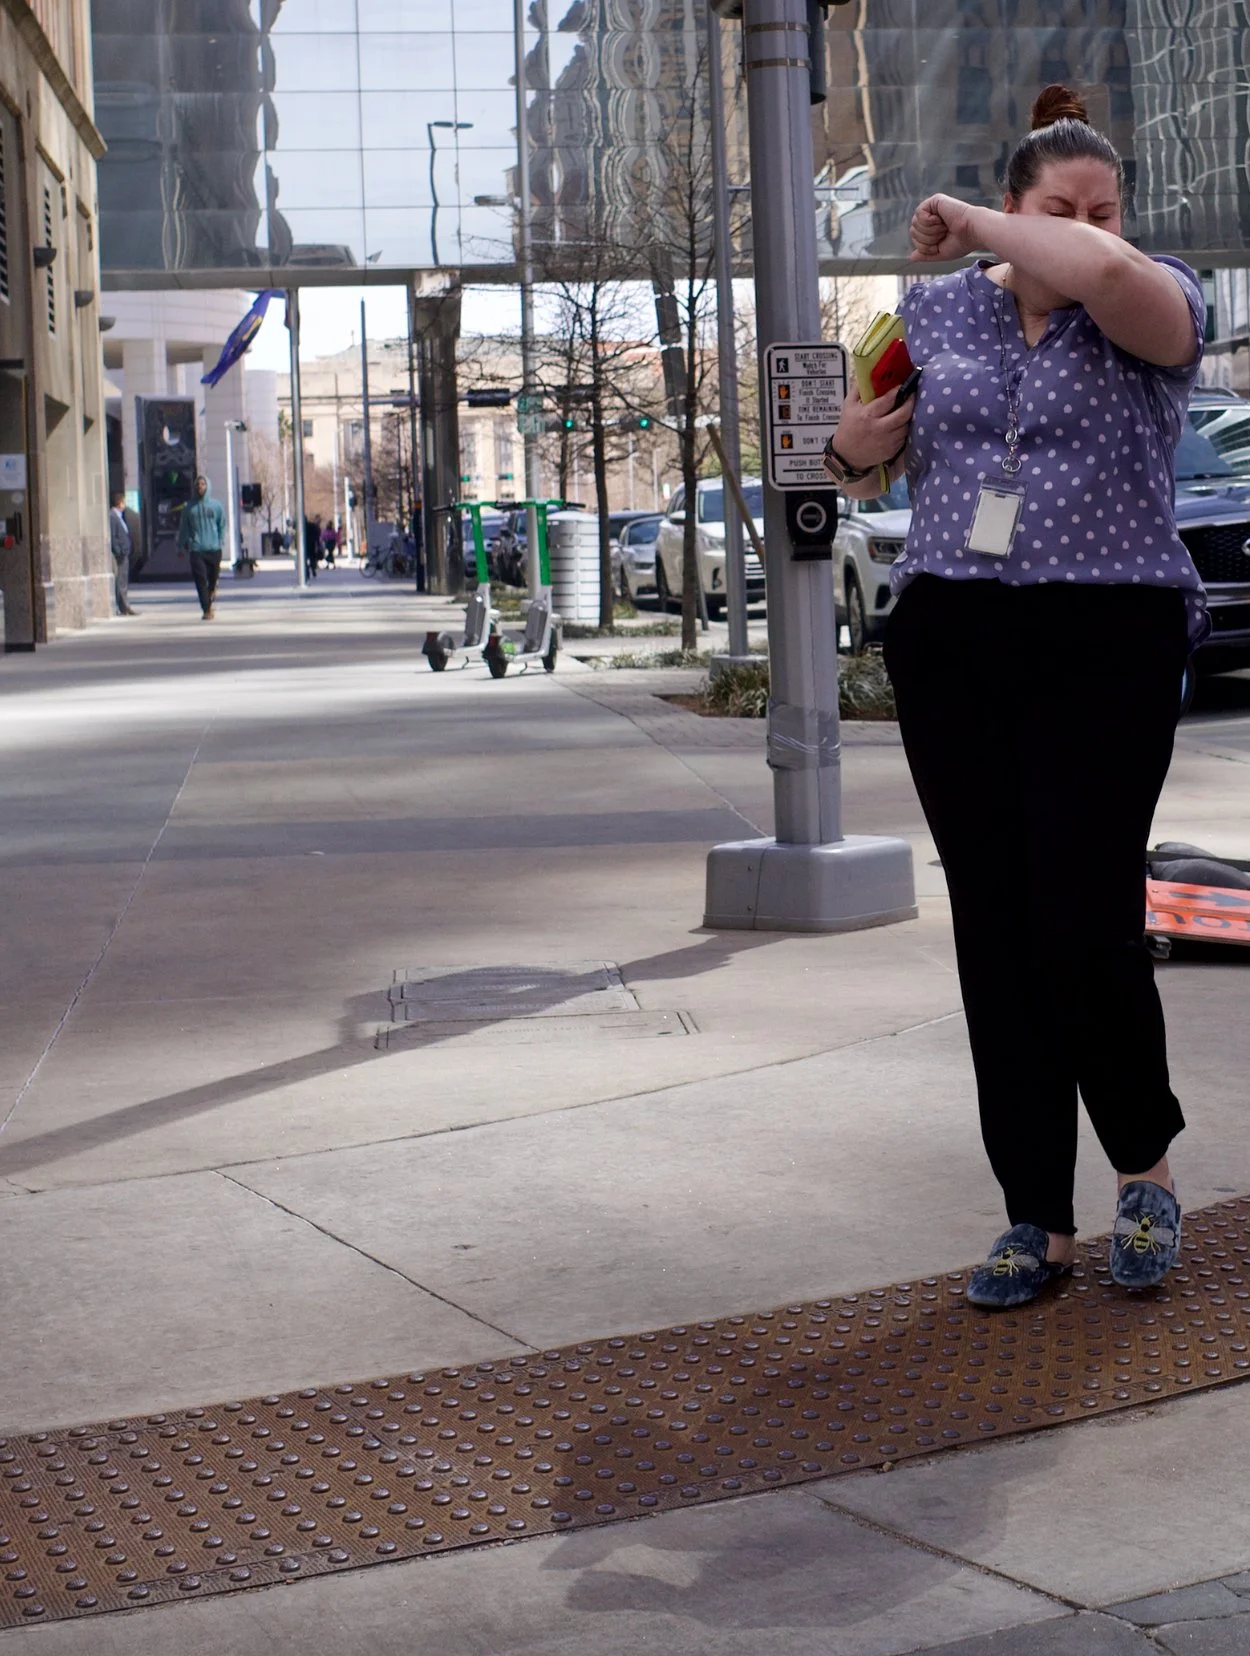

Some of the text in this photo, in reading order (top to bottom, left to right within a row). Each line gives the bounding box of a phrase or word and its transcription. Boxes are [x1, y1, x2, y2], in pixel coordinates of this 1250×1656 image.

[794, 352, 838, 361] START CROSSING
[812, 405, 841, 413] REMAINING
[803, 437, 818, 445] DON'T
[789, 459, 807, 467] PUSH
